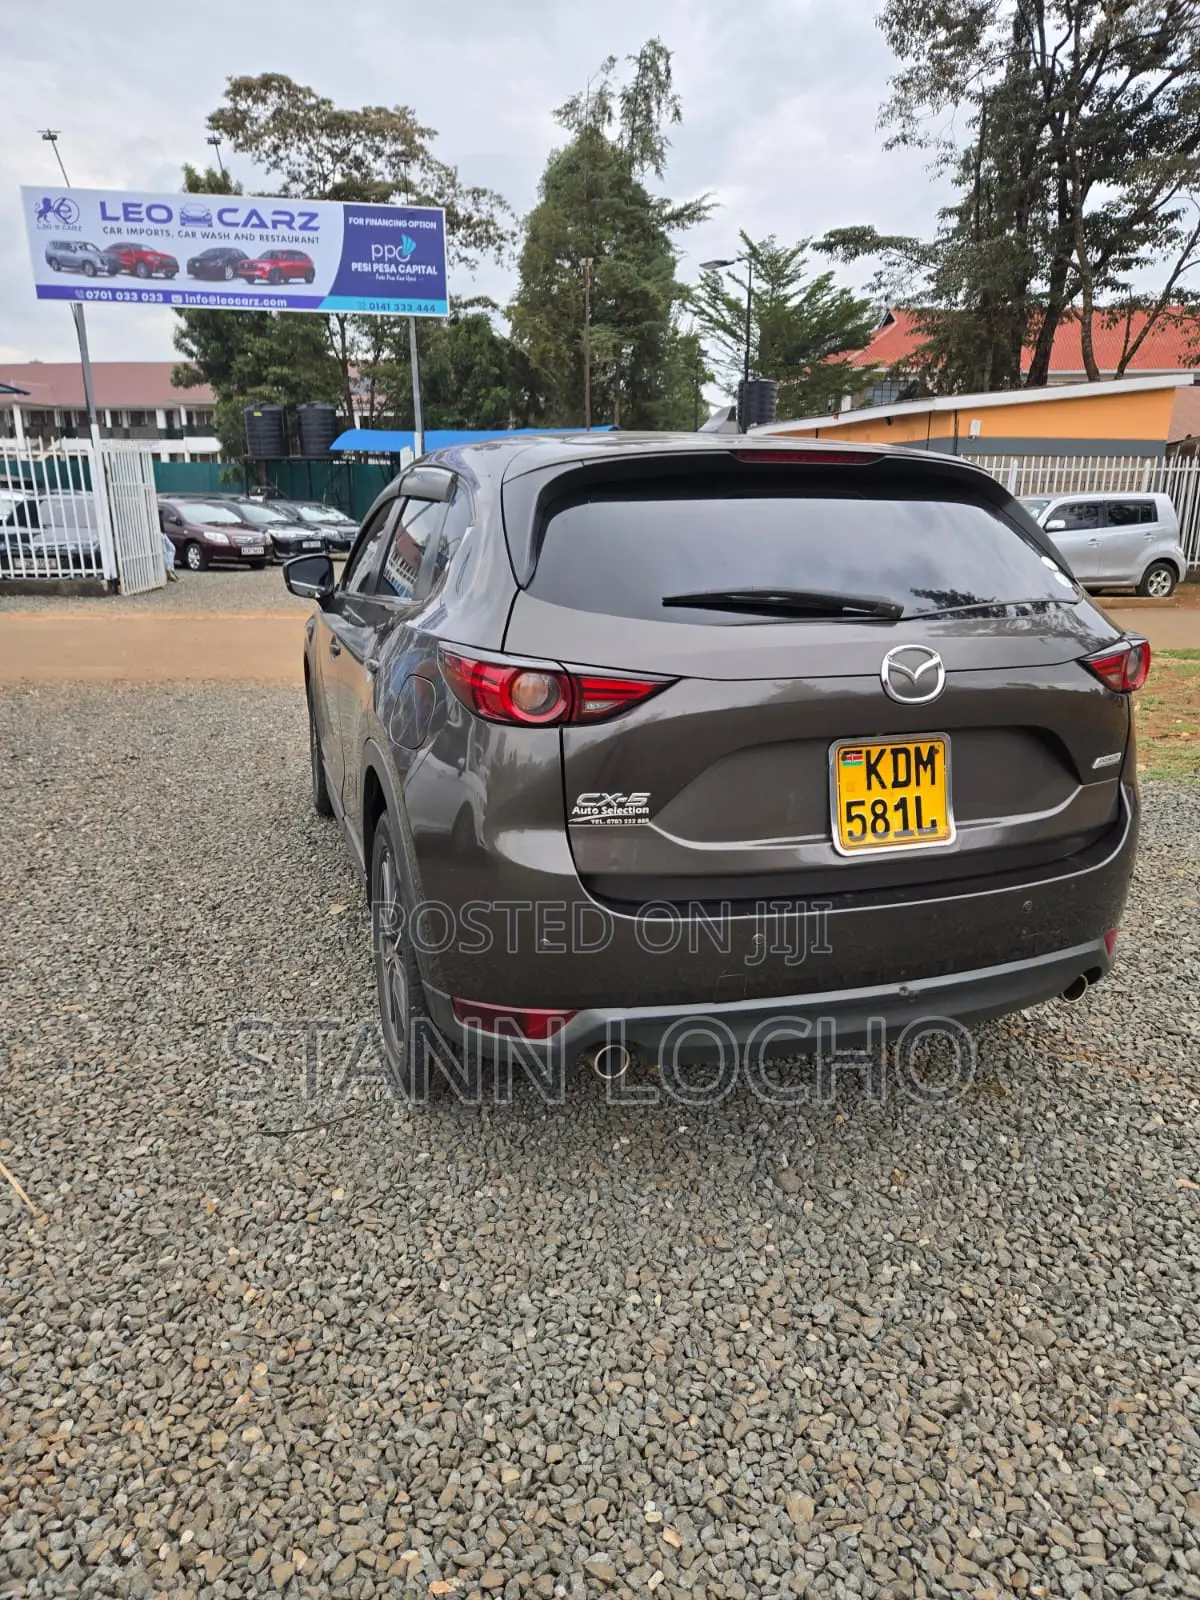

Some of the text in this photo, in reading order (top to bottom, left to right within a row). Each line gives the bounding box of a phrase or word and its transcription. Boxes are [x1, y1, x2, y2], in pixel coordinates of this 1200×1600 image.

[99, 201, 320, 232] LEO CARZ
[349, 217, 437, 230] FOR FINANCING OPTION
[103, 226, 320, 244] CAR IMPORTS, CAR WASH AND RESTAURANT
[351, 262, 438, 275] PESI PESA CAPITAL
[85, 290, 288, 307] 0701 033 033 info@leocarz.com
[865, 745, 937, 791] KDM
[576, 792, 652, 807] CX-5
[571, 806, 650, 815] Auto Selection
[845, 795, 938, 842] 581L
